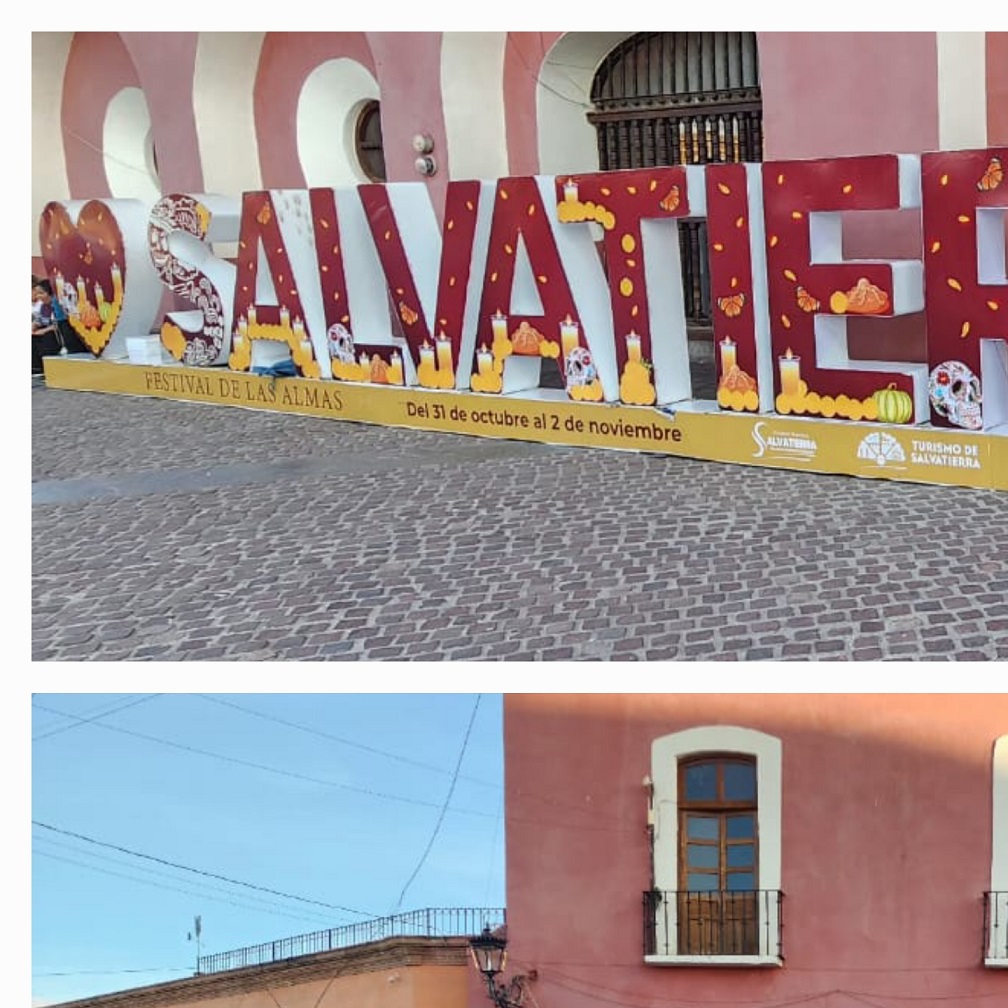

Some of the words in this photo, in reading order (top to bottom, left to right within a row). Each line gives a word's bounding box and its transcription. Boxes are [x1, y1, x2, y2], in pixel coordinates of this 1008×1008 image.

[145, 371, 214, 396] FESTIVAL
[220, 381, 239, 398] DE
[245, 382, 276, 403] LAS
[282, 387, 343, 411] ALMAS
[407, 402, 428, 418] Del
[432, 404, 446, 420] 31
[450, 406, 467, 422] de
[471, 408, 529, 428] octubre
[533, 413, 546, 430] al
[551, 415, 560, 431] 2
[565, 414, 583, 433] de
[589, 418, 682, 442] noviembre
[911, 440, 961, 455] TURISMO
[964, 444, 979, 456] DE
[911, 453, 981, 469] SALVATIERRA
